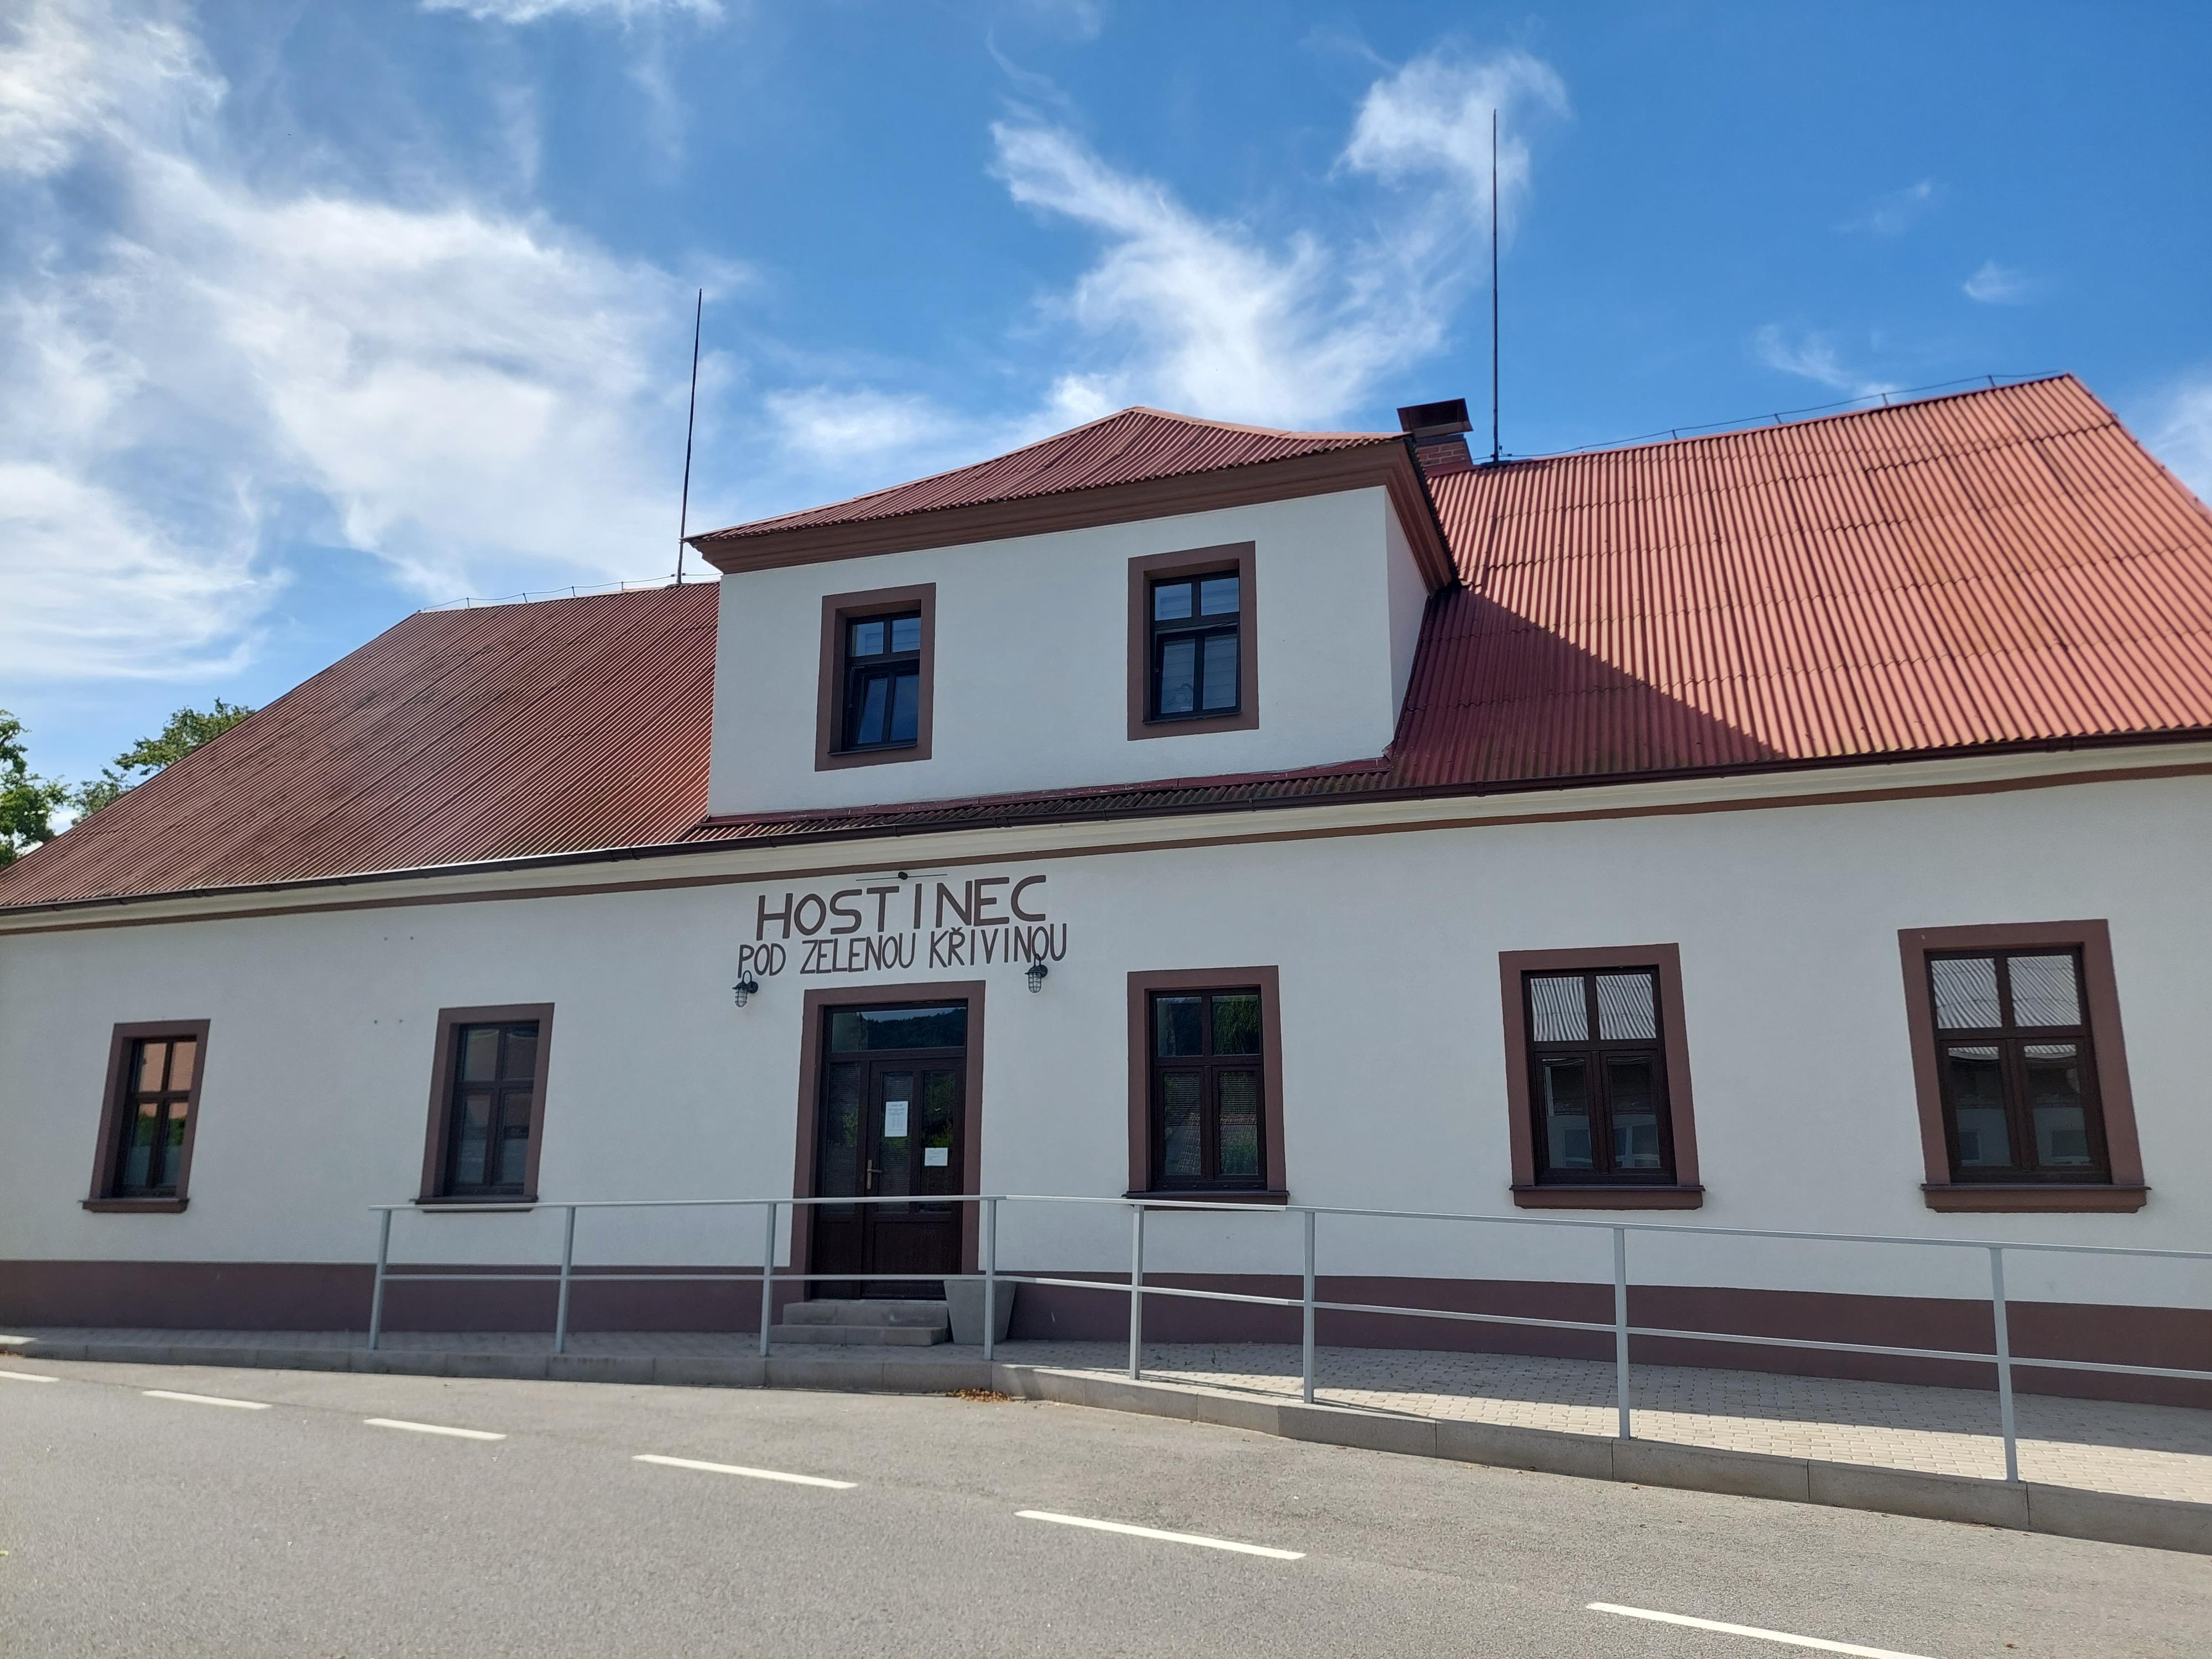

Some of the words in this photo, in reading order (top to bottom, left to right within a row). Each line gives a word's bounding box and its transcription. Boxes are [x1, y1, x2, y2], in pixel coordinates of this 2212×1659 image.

[757, 875, 1046, 941] HOSTINEC
[738, 943, 786, 978] POD
[800, 933, 916, 974] ZELENOU
[929, 924, 1067, 968] KŘIVINOU
